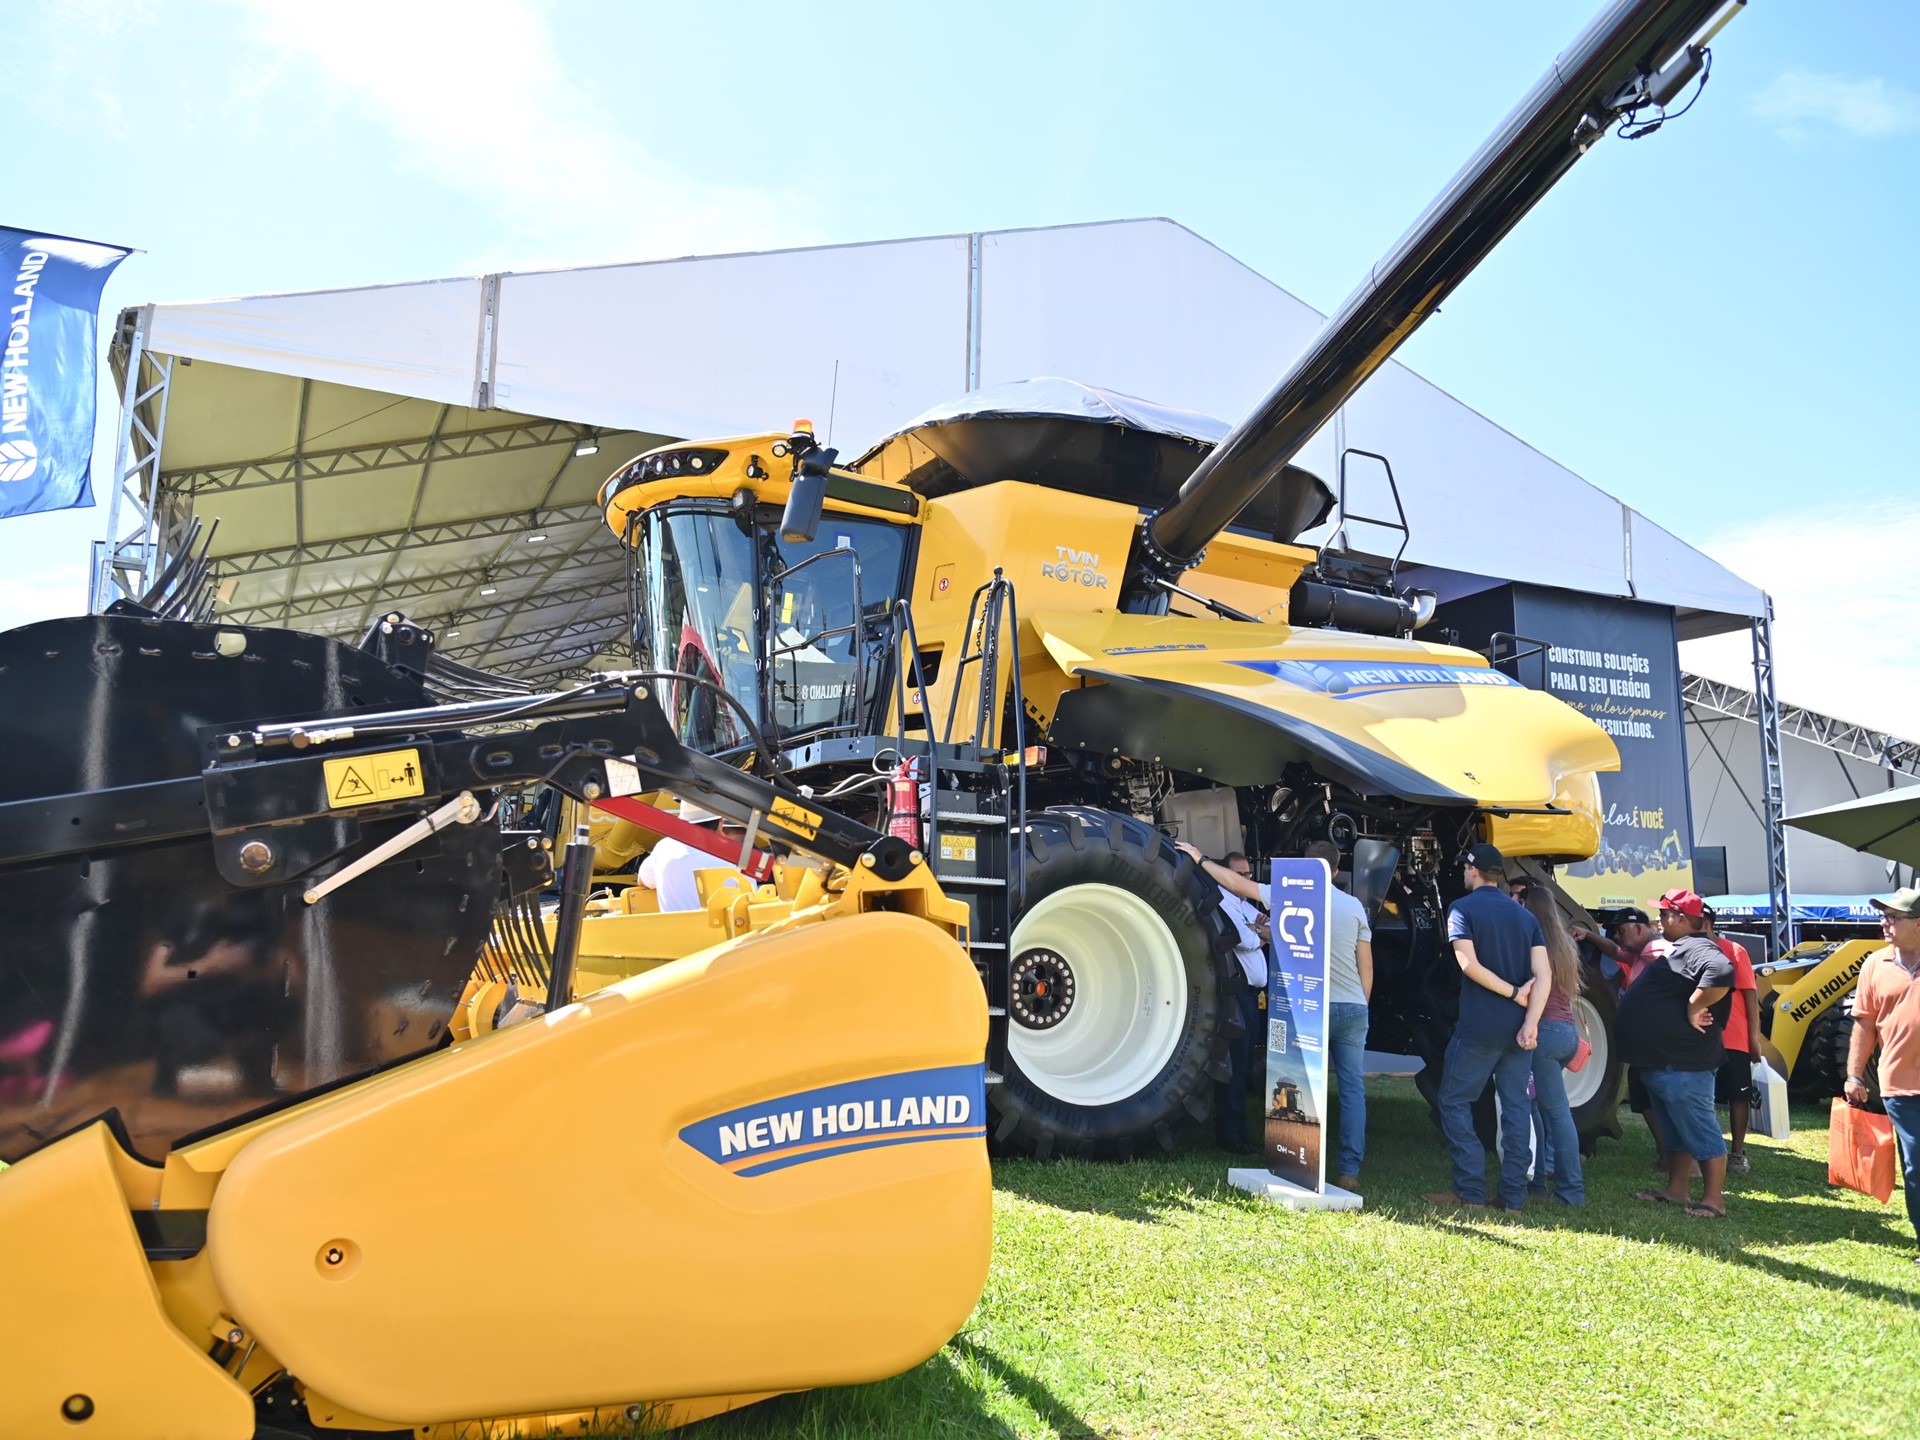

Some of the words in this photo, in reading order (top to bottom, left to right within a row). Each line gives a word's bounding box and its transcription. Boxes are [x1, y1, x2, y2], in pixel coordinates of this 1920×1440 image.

[4, 252, 49, 368] HOLLAND
[2, 372, 29, 434] NEW
[1056, 546, 1099, 568] TWIN
[1042, 562, 1108, 590] ROTOR
[1549, 647, 1602, 668] CONSTRUIR
[1604, 653, 1650, 676] SOLUÇÕES
[1343, 670, 1400, 684] NEW
[1398, 670, 1509, 685] HOLLAND
[1551, 672, 1578, 691] PARA
[1580, 675, 1587, 692] O
[1589, 676, 1607, 694] SEU
[1610, 677, 1650, 699] NEGÓCIO
[1591, 697, 1667, 721] valorizamos
[1633, 806, 1639, 828] É
[1640, 808, 1664, 829] VOCÊ
[1790, 993, 1821, 1022] NEW
[719, 1110, 803, 1156] NEW
[812, 1095, 970, 1137] HOLLAND
